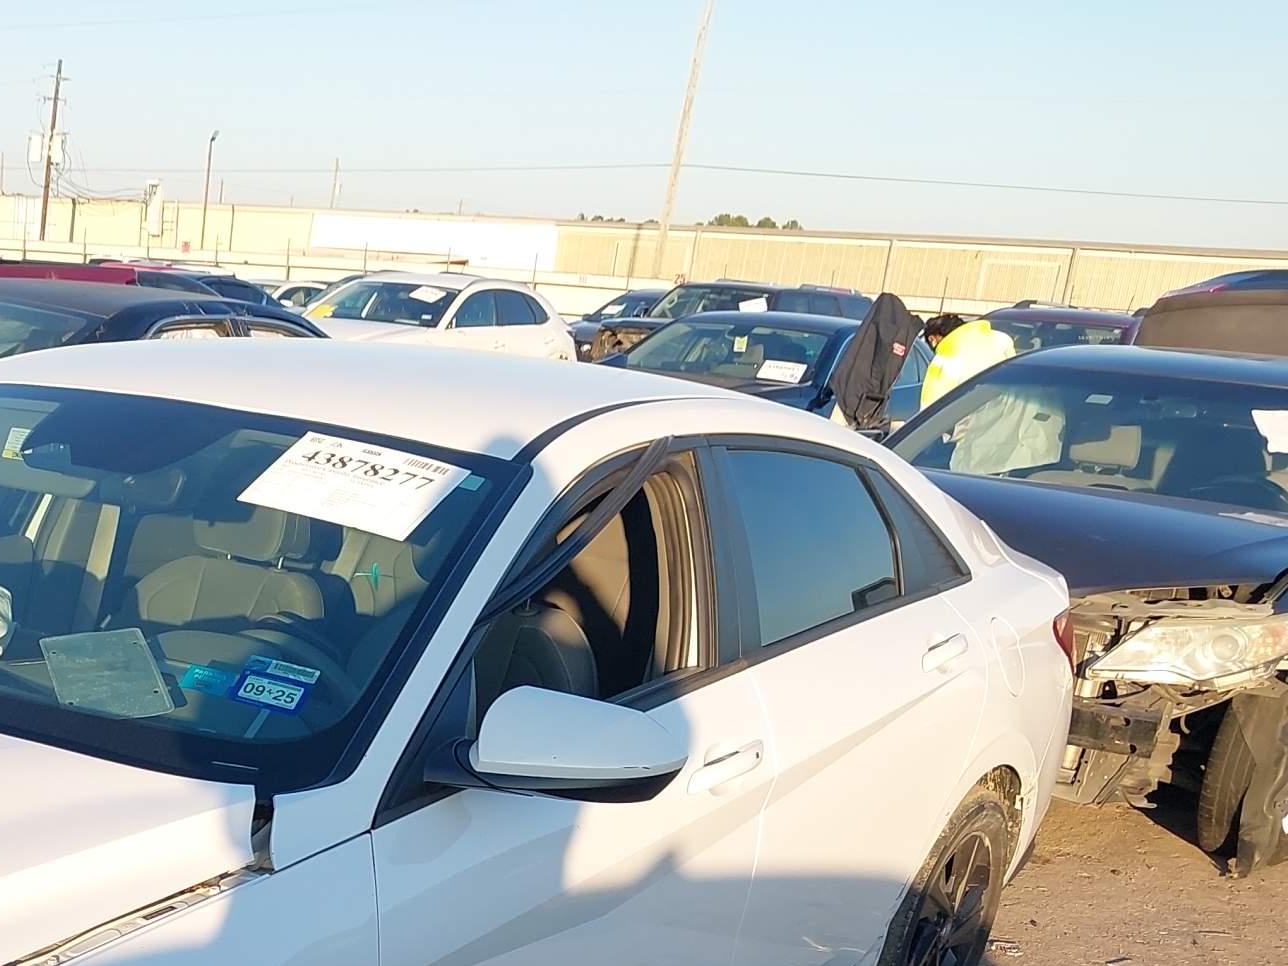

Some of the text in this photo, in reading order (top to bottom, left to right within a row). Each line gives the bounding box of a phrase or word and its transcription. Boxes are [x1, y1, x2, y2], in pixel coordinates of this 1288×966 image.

[301, 449, 435, 490] 43878277
[243, 682, 266, 696] 09
[272, 689, 297, 704] 25
